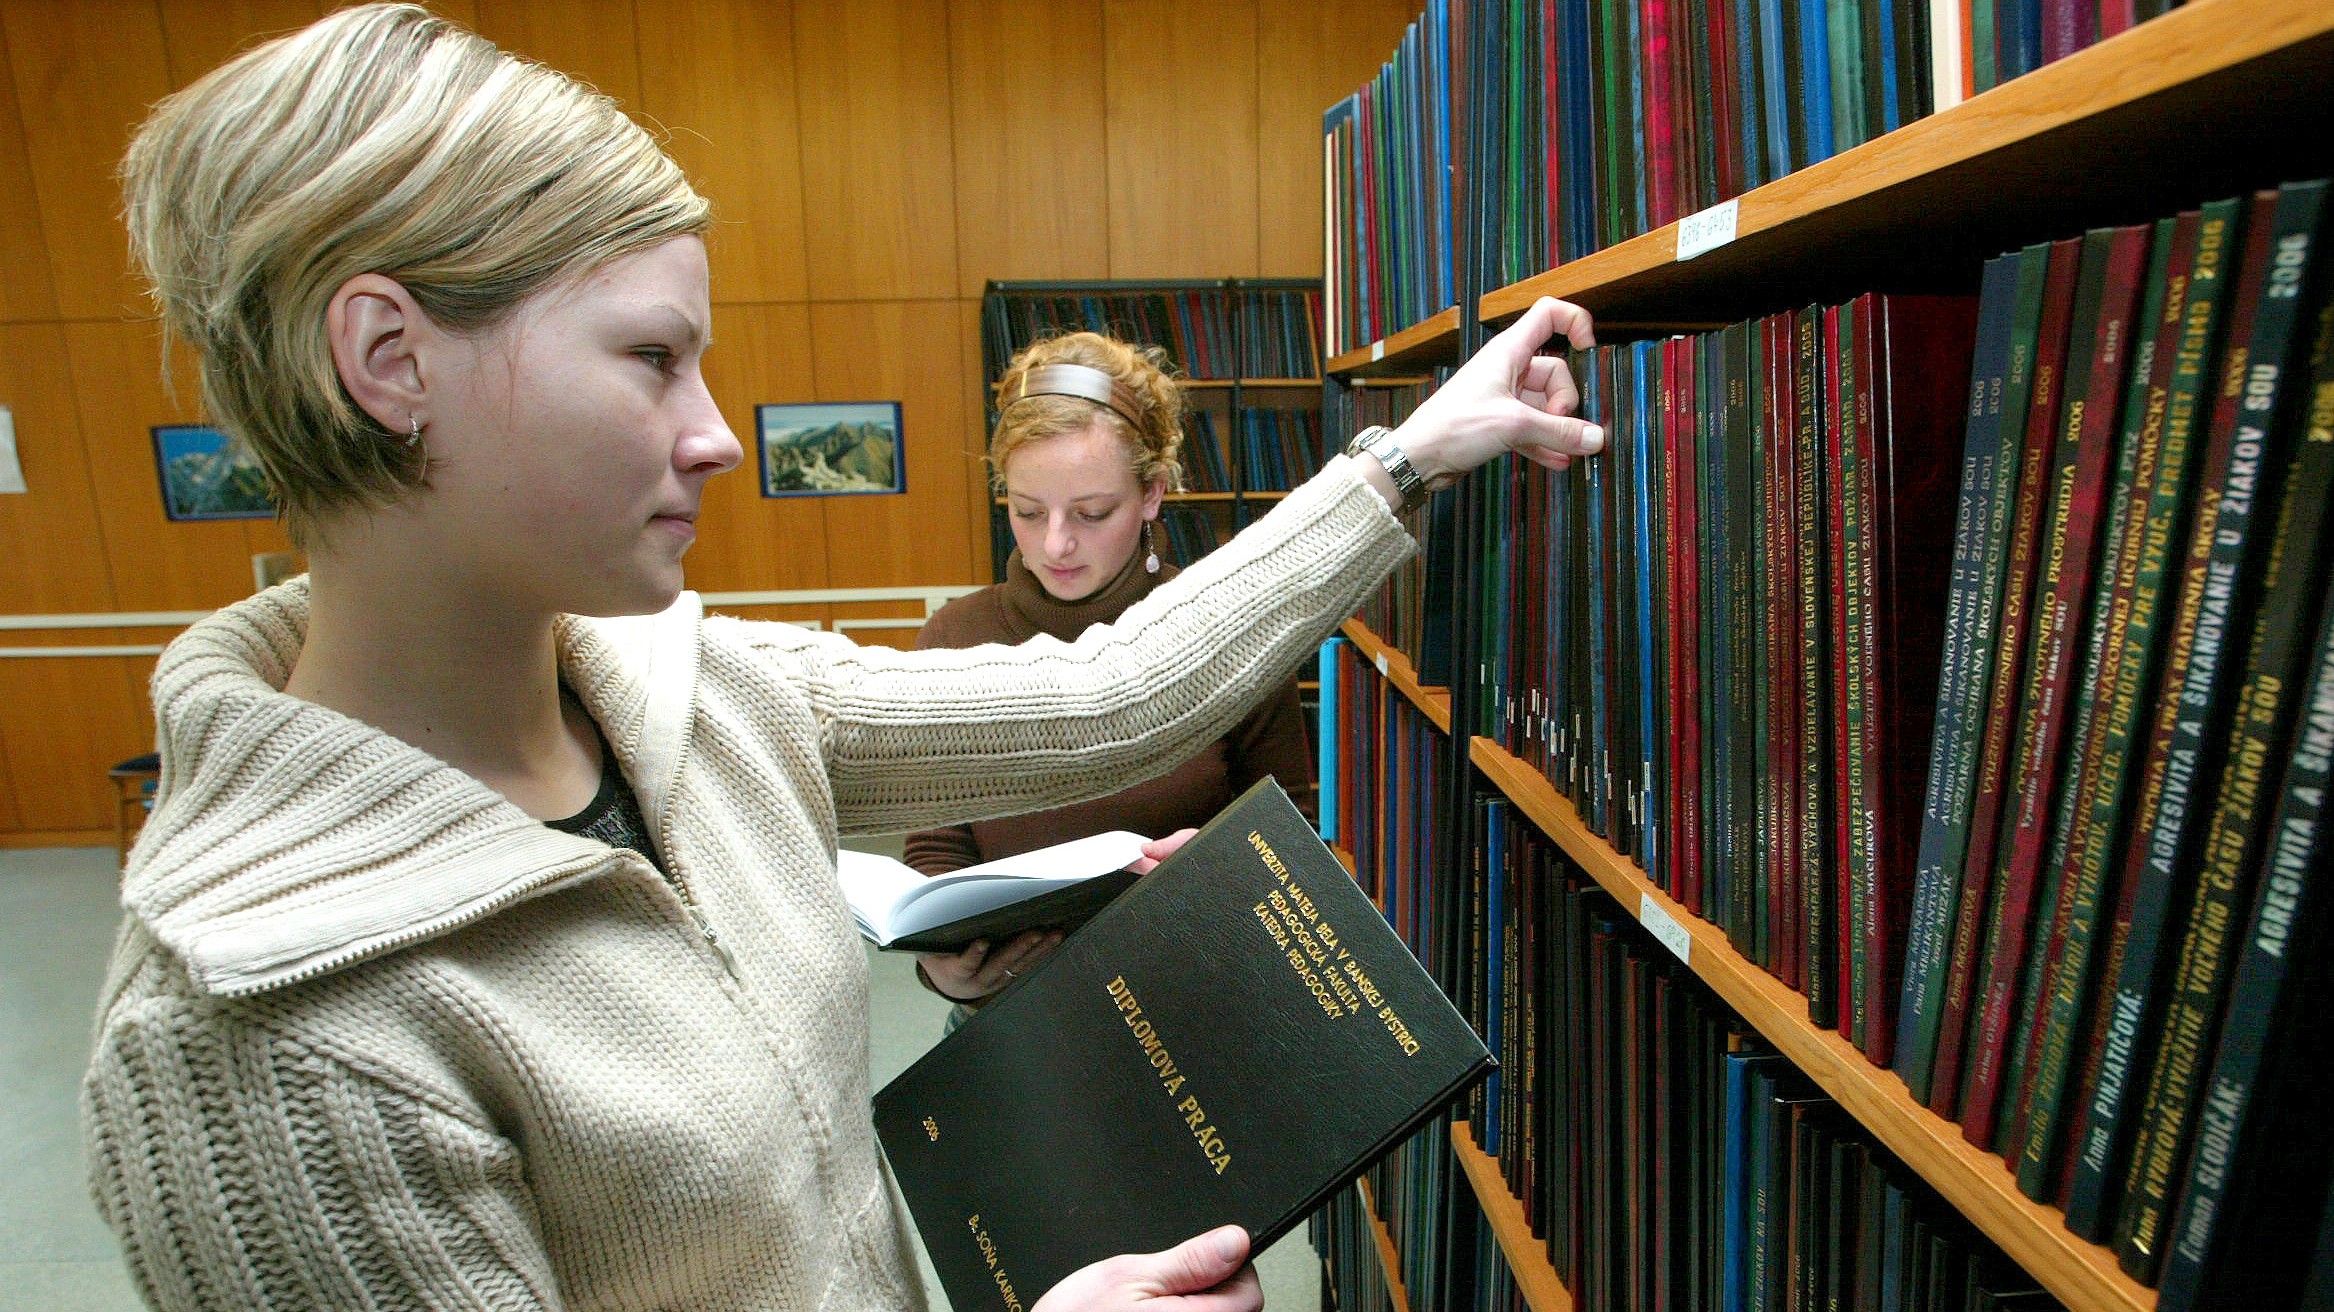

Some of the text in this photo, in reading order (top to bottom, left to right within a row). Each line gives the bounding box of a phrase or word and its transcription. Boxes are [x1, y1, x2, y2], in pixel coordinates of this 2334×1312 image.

[2266, 230, 2310, 301] 2006
[2025, 447, 2041, 485] SOU
[2036, 364, 2053, 405] 2006
[2242, 361, 2279, 413] SOU
[1860, 458, 1868, 487] SOU
[2045, 463, 2077, 582] PROSTREDIA
[2065, 400, 2085, 441] 2006
[2217, 424, 2266, 515] ŽIAKOV
[1804, 539, 1815, 628] SLOVENSKEJ
[1938, 707, 1948, 718] A
[1954, 569, 1964, 579] U
[1964, 456, 1977, 490] SOU
[1972, 380, 1985, 416] 2006
[1951, 711, 1962, 722] A
[1969, 569, 1979, 581] U
[1980, 455, 1993, 490] SOU
[1988, 377, 2002, 413] 2006
[1963, 647, 1986, 731] OCHRANA
[1990, 437, 2014, 531] OBJEKTOV
[2010, 344, 2026, 384] 2006
[2214, 527, 2242, 546] U
[2054, 600, 2068, 631] SOU
[2155, 737, 2170, 751] A
[2169, 565, 2206, 671] RIADENIA
[2180, 560, 2237, 706] ŠIKANOVANIE
[2073, 917, 2088, 931] A
[2131, 586, 2155, 627] PRE
[2178, 719, 2203, 736] A
[2220, 735, 2268, 820] ŽIAKOV
[2247, 674, 2283, 724] SOU
[2147, 747, 2197, 873] AGRESIVITA
[2252, 815, 2316, 957] AGRESIVITA
[2289, 784, 2323, 806] A
[1248, 830, 1421, 1057] UNIVERZITA MATEJA BELA V BANSKEJ BYSTRICI
[1253, 902, 1344, 1020] KATEDRA PEDAGOGIKY
[1267, 889, 1361, 1016] PEDAGOGICKÁ FAKULTA
[2081, 1125, 2111, 1171] Anna
